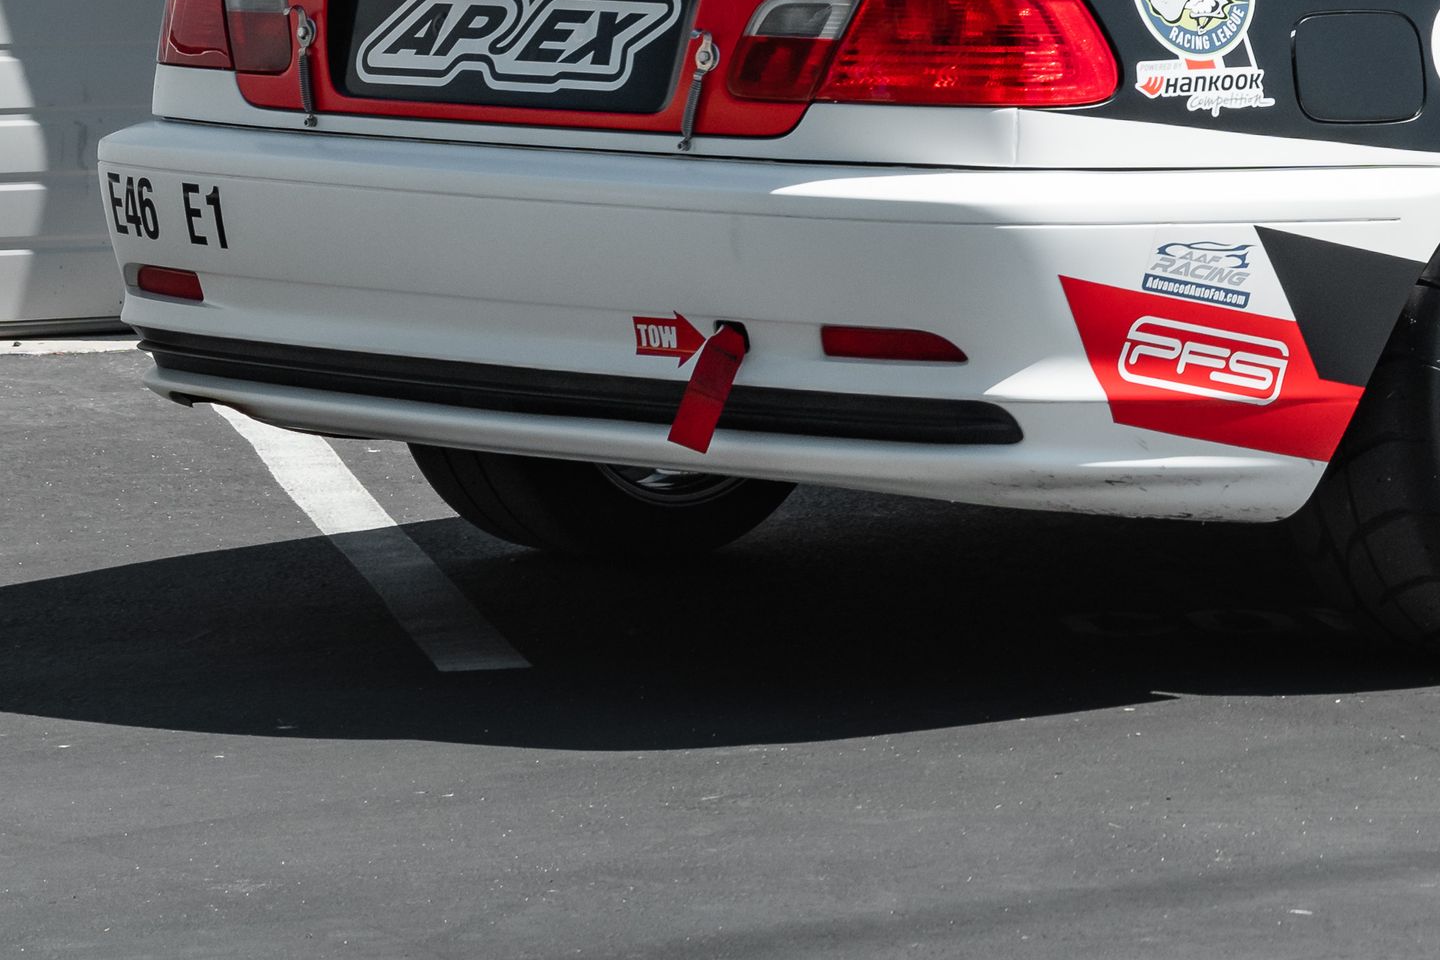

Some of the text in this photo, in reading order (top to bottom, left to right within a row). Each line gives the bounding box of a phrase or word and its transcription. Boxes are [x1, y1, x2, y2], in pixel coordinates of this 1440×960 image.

[1169, 5, 1245, 50] RACING LEAGUE
[107, 172, 228, 249] E46 E1
[1150, 257, 1250, 286] RACING
[1179, 251, 1222, 264] AAF
[1146, 276, 1246, 305] AdvancedAutoFab.com
[637, 324, 678, 349] TOW
